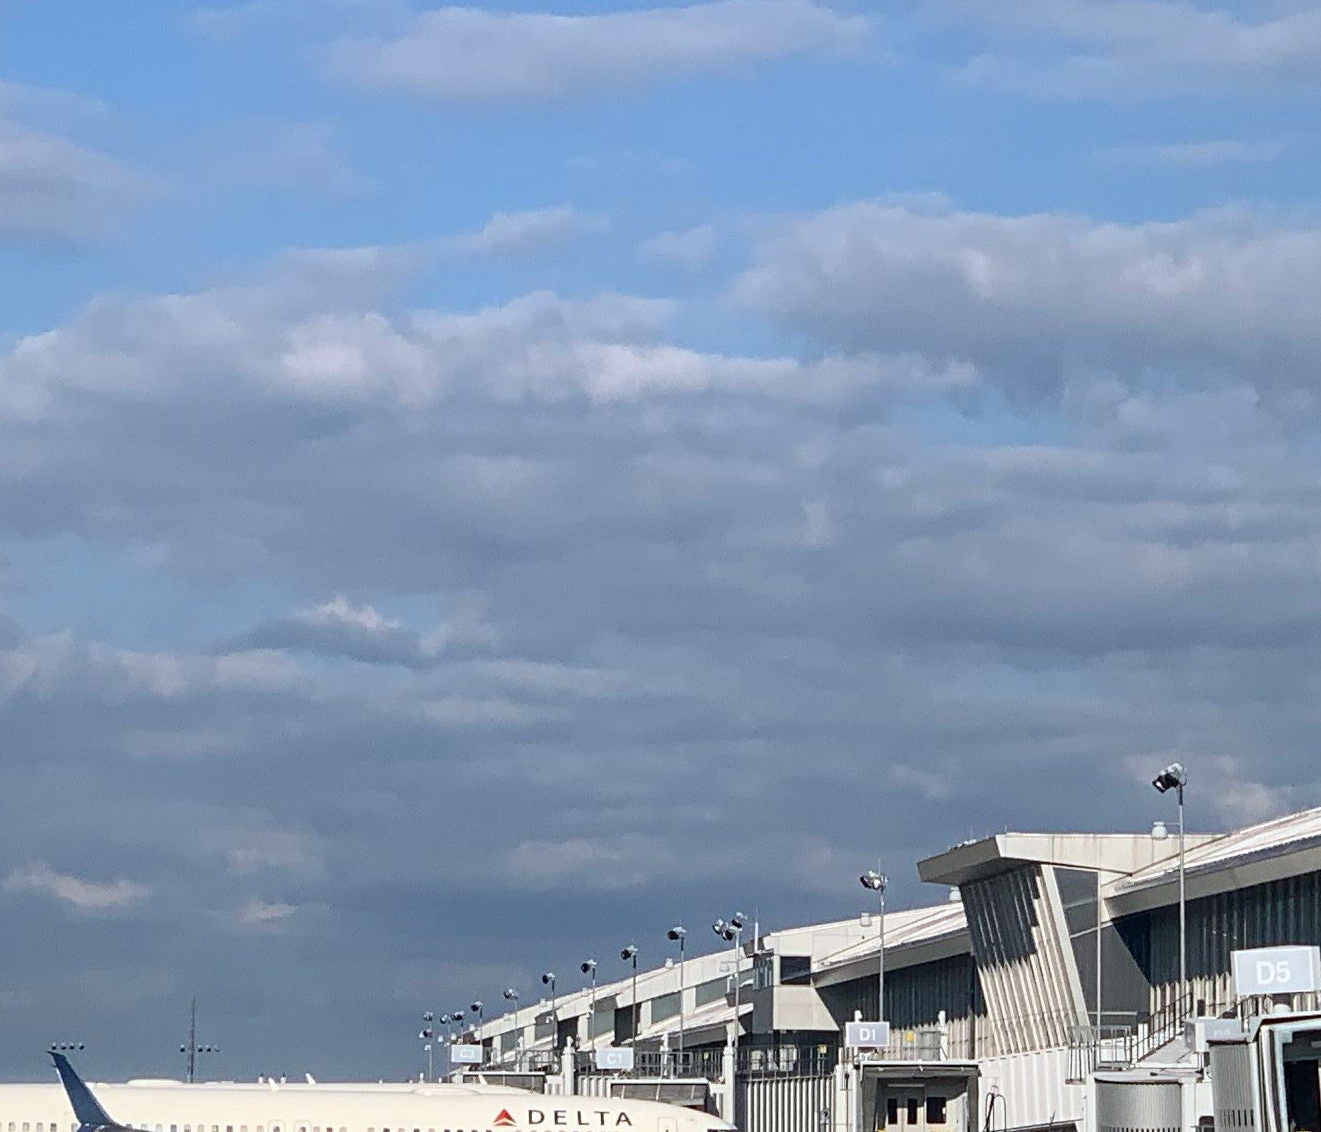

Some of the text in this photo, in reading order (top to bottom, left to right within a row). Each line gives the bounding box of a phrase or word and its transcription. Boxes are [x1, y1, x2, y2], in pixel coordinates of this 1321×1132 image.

[1255, 960, 1291, 985] D5
[859, 1028, 875, 1041] D1
[606, 1052, 623, 1064] C1
[528, 1109, 633, 1126] DELTA
